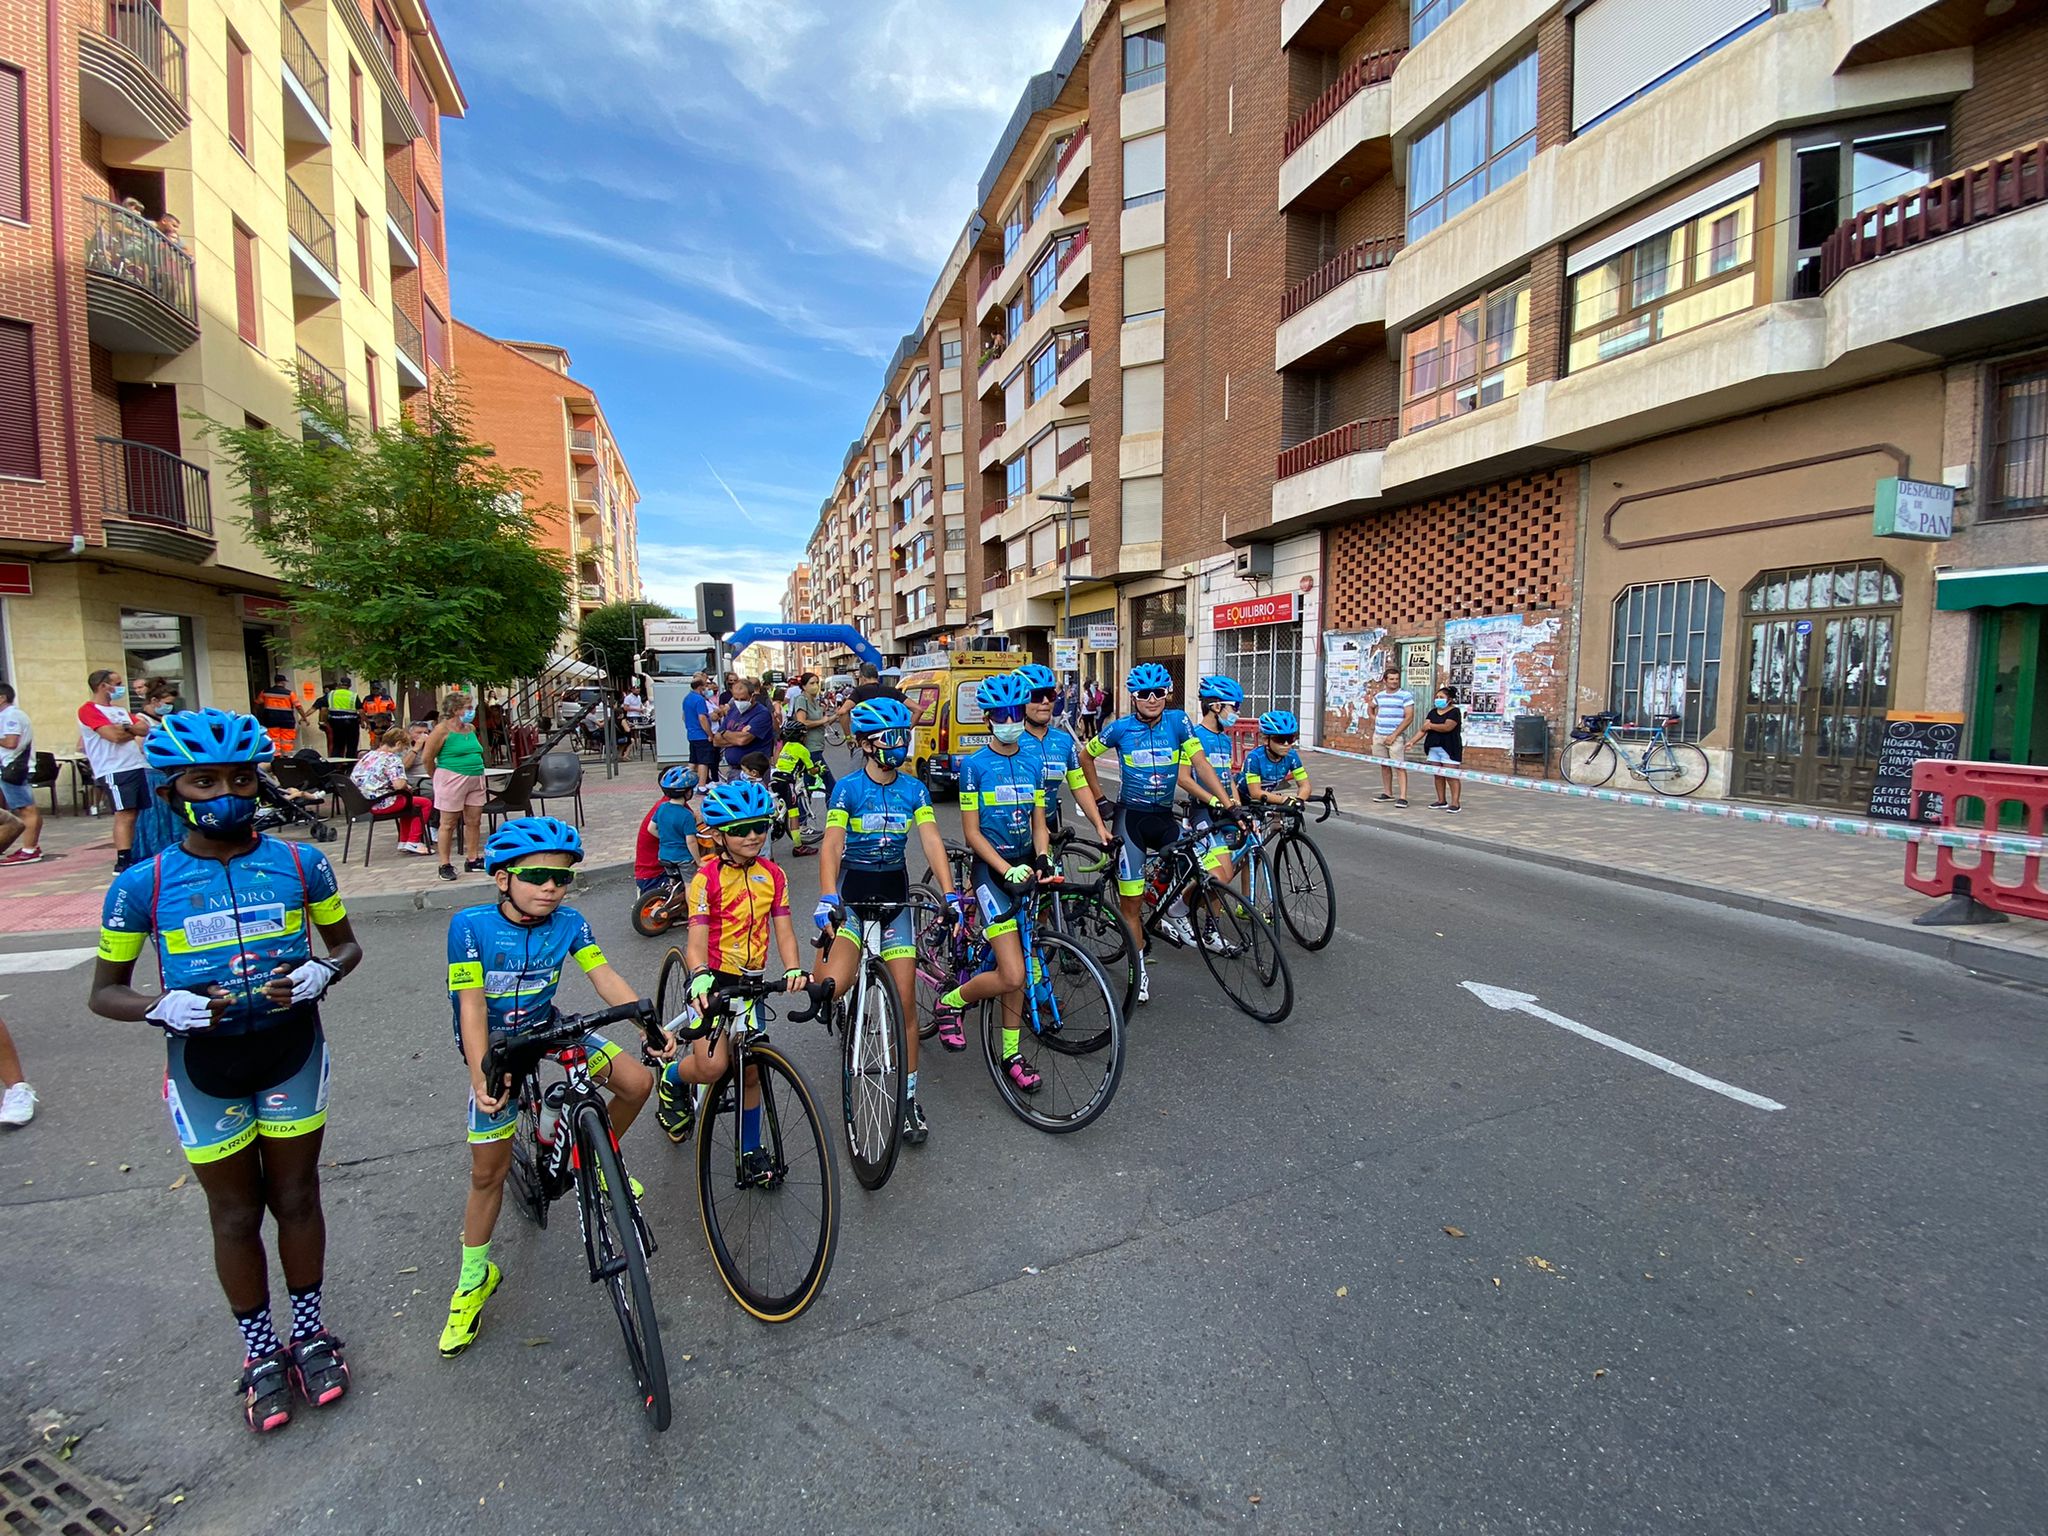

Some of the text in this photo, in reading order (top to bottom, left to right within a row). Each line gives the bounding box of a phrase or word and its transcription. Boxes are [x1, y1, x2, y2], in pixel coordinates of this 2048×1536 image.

[1898, 481, 1950, 500] DESPACHO
[1913, 500, 1923, 509] DE
[1919, 512, 1950, 535] PAN
[1226, 602, 1275, 623] EQUILIBRIO
[754, 626, 797, 636] PABLO
[1410, 644, 1430, 652] VENDE
[1883, 738, 1923, 749] HOGAZA
[1881, 748, 1921, 757] HOGAZA
[1870, 805, 1908, 817] BARRA
[112, 888, 128, 916] isaval
[209, 890, 275, 910] MORO
